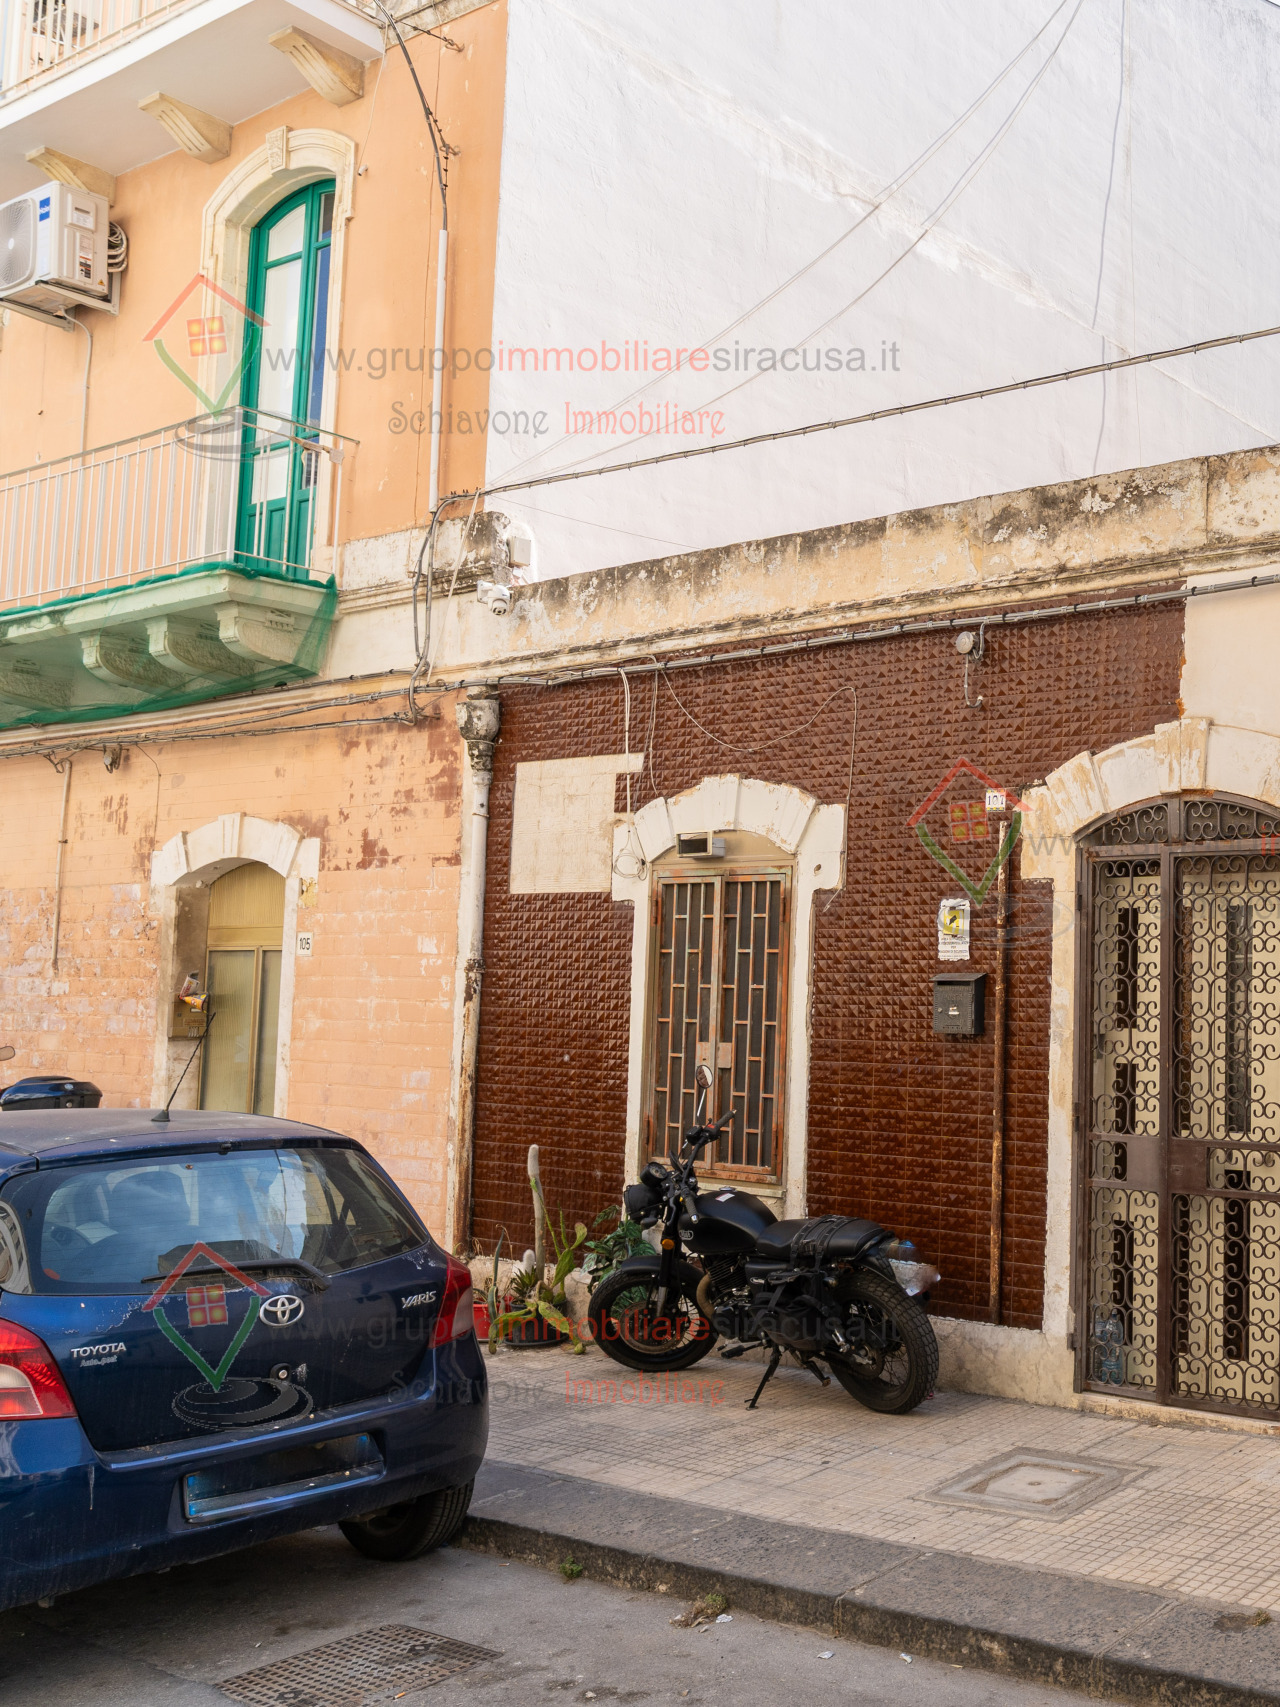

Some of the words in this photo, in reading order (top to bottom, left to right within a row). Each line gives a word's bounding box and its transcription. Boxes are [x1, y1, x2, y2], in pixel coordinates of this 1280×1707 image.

[987, 794, 1005, 806] 107
[299, 937, 311, 951] 105
[70, 1341, 127, 1359] TOYOTA
